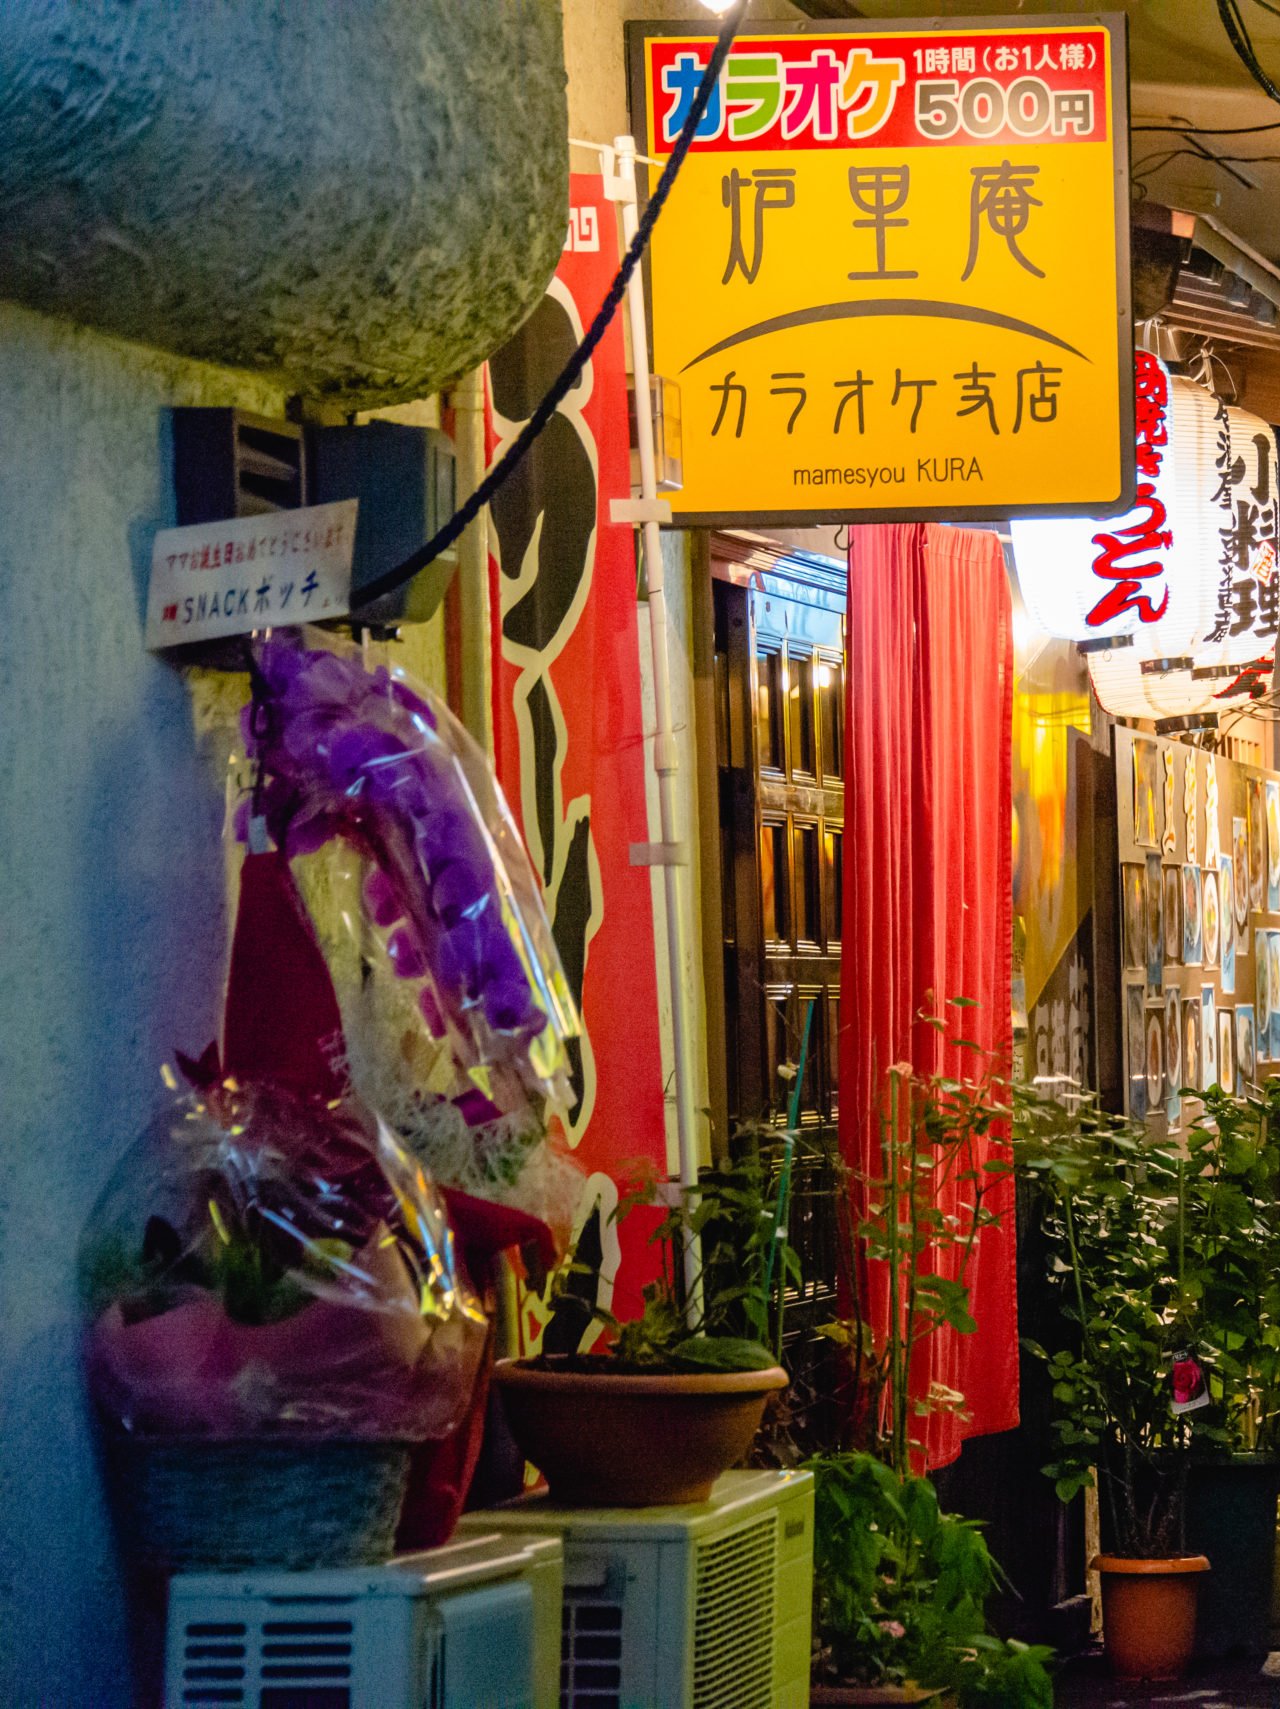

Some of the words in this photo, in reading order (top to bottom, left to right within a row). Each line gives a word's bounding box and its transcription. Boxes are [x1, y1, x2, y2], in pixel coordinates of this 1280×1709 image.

[662, 47, 905, 142] カラオケ
[914, 77, 1094, 141] 500円
[710, 360, 1063, 439] カラオケ支店
[793, 464, 906, 489] mamesyou
[917, 457, 984, 482] KURA
